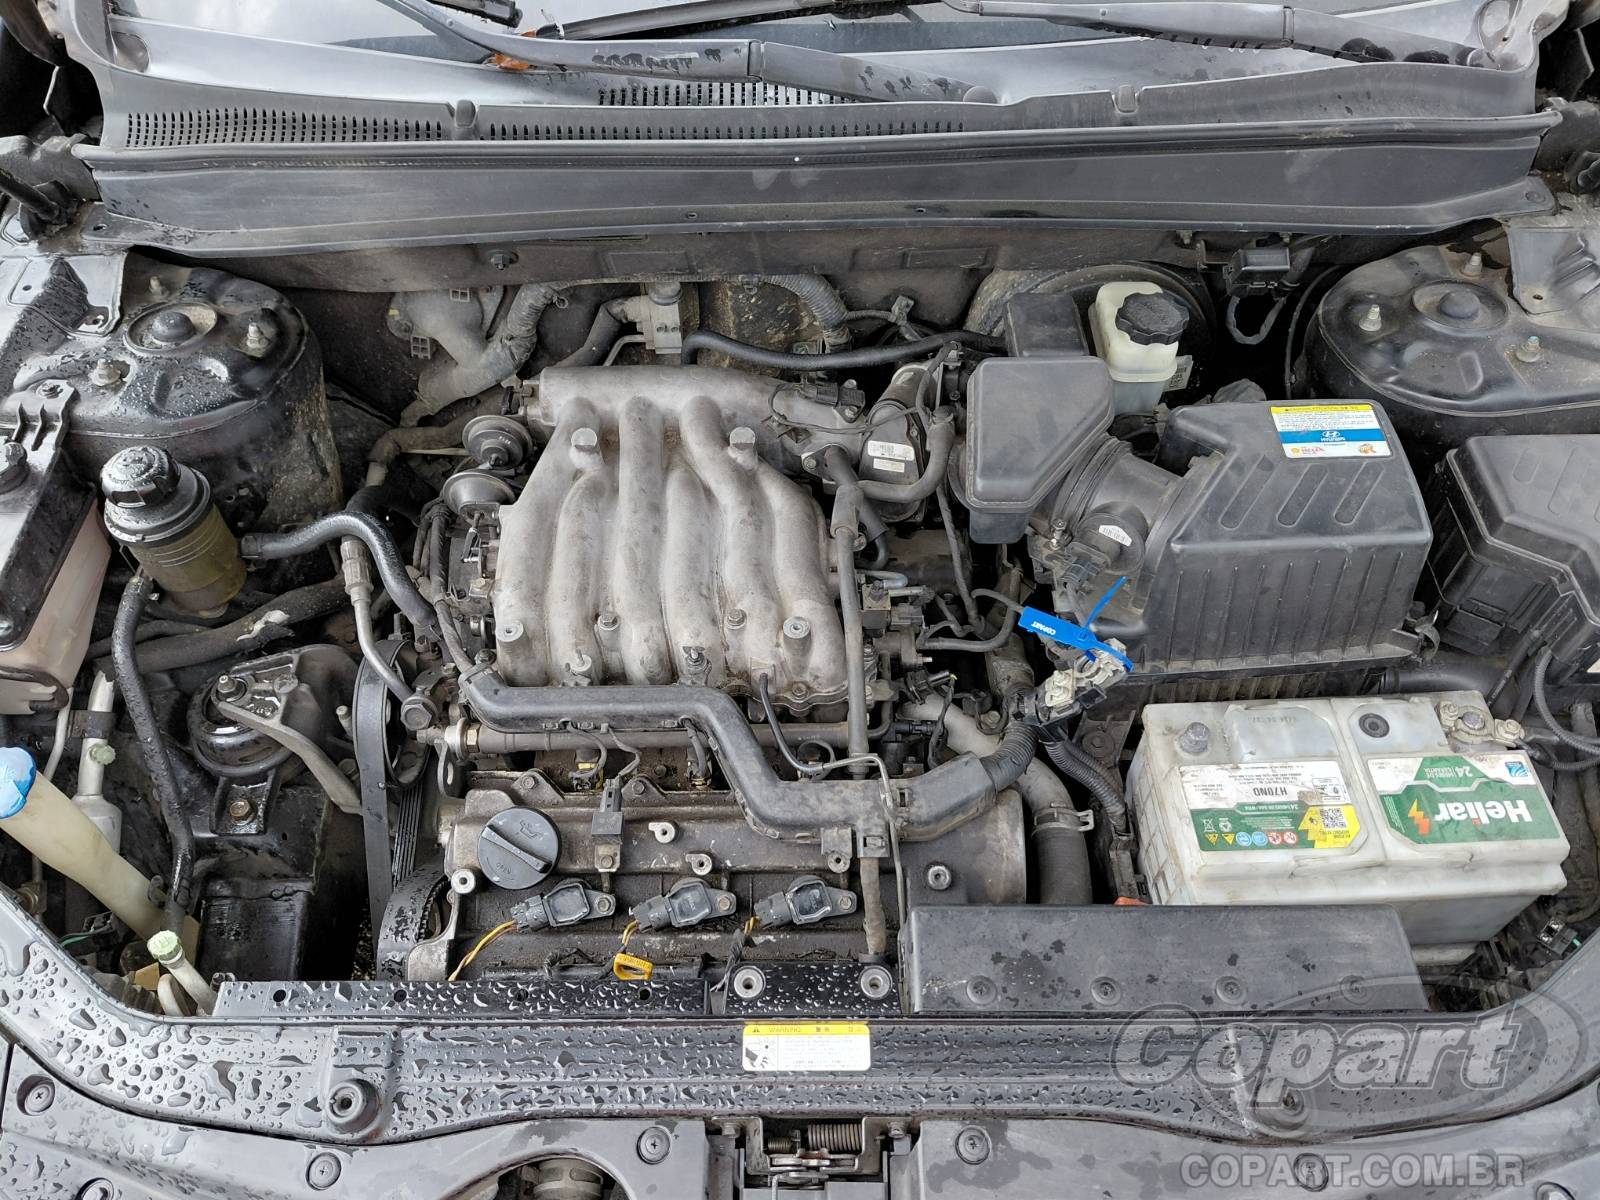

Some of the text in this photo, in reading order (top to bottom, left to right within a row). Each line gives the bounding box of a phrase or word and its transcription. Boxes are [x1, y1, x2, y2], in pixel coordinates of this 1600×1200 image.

[1030, 621, 1057, 636] COPART
[1455, 766, 1473, 778] 24
[1434, 800, 1532, 824] Heliar
